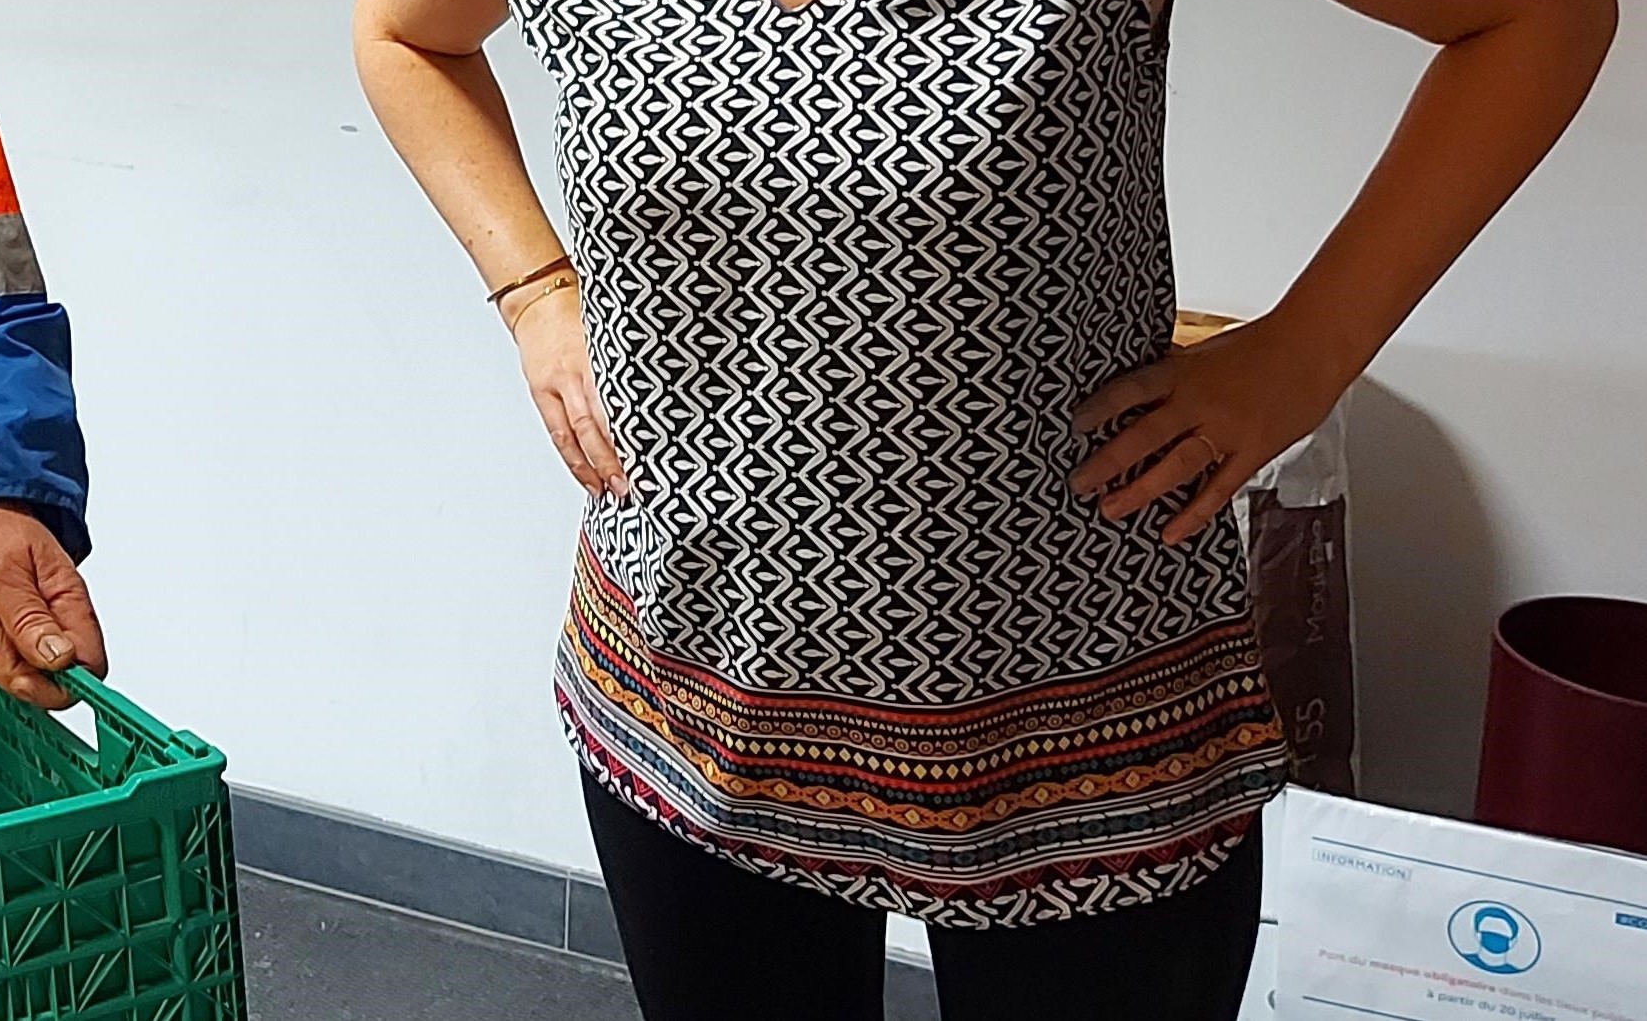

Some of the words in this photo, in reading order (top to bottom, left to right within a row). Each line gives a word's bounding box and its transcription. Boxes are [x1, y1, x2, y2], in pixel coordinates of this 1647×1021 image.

[1369, 960, 1421, 977] masque
[1423, 971, 1496, 993] obligatoire
[1437, 992, 1475, 1007] partir
[1478, 1000, 1496, 1013] du
[1499, 1004, 1517, 1016] 20
